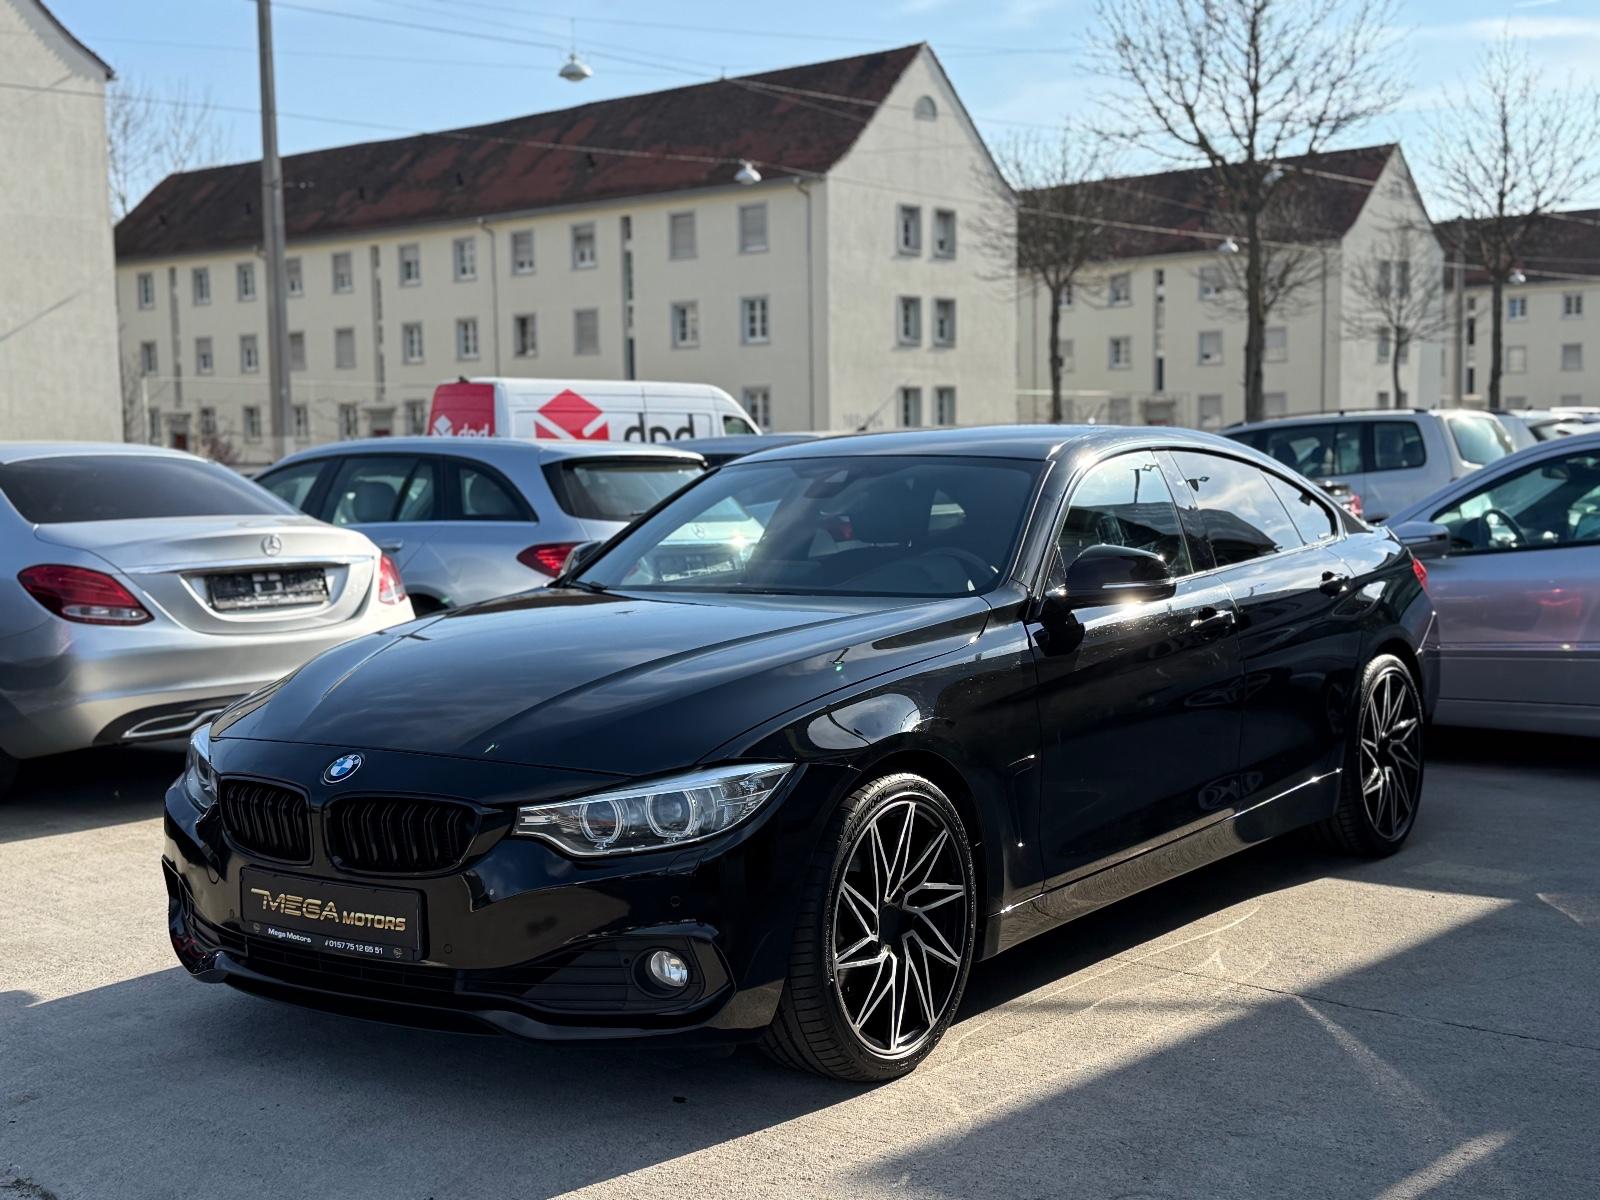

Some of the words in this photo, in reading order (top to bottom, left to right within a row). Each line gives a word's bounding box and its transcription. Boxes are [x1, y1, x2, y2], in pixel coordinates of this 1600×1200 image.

[251, 888, 339, 923] MEGA
[342, 911, 406, 931] MOTORS
[267, 927, 286, 938] Mega
[286, 932, 312, 943] Motors
